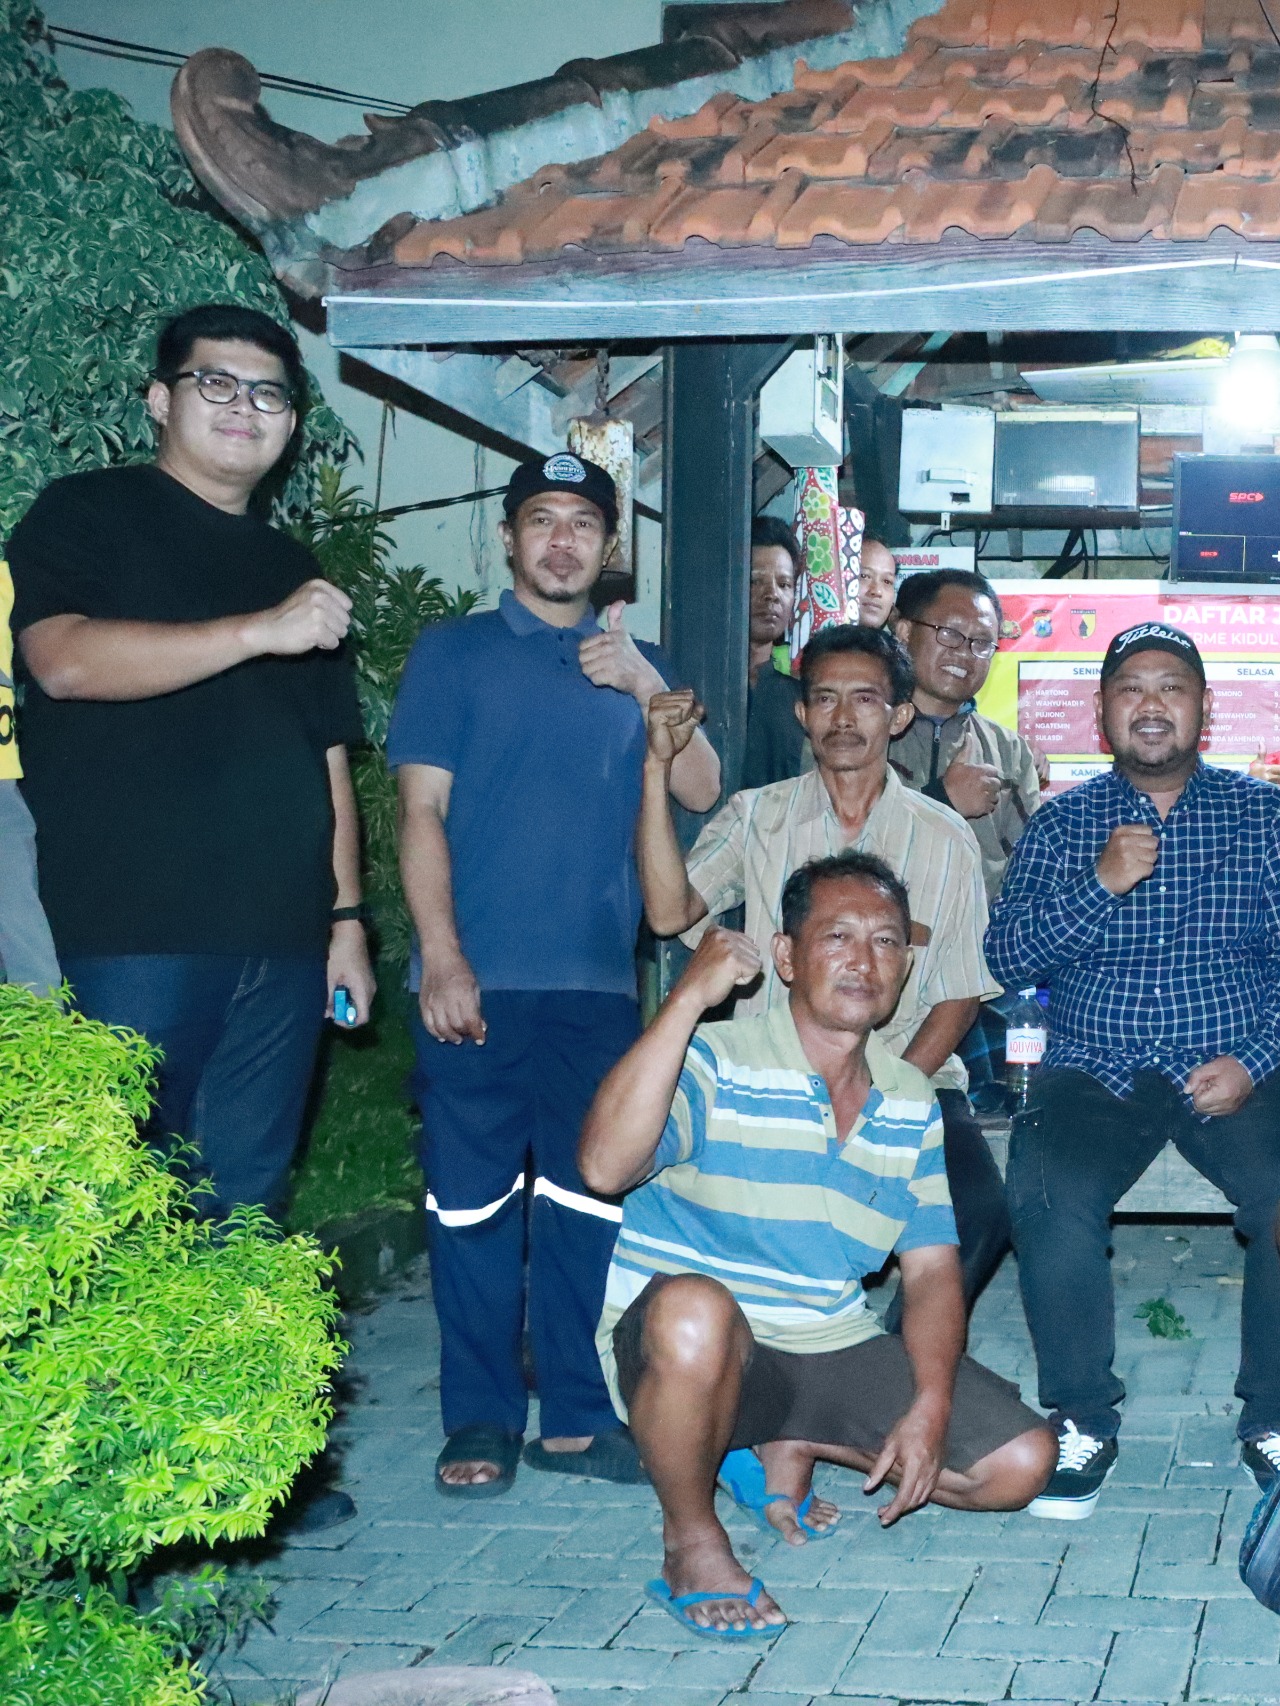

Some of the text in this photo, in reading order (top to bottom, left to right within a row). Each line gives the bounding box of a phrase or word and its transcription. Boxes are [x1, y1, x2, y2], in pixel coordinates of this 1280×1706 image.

[894, 554, 940, 566] ONGAN
[1163, 605, 1266, 625] DAFTAR
[1231, 632, 1279, 646] KIDUL
[1073, 667, 1102, 676] SENIN
[1236, 668, 1275, 676] SELASA
[1071, 768, 1102, 777] KAMIS
